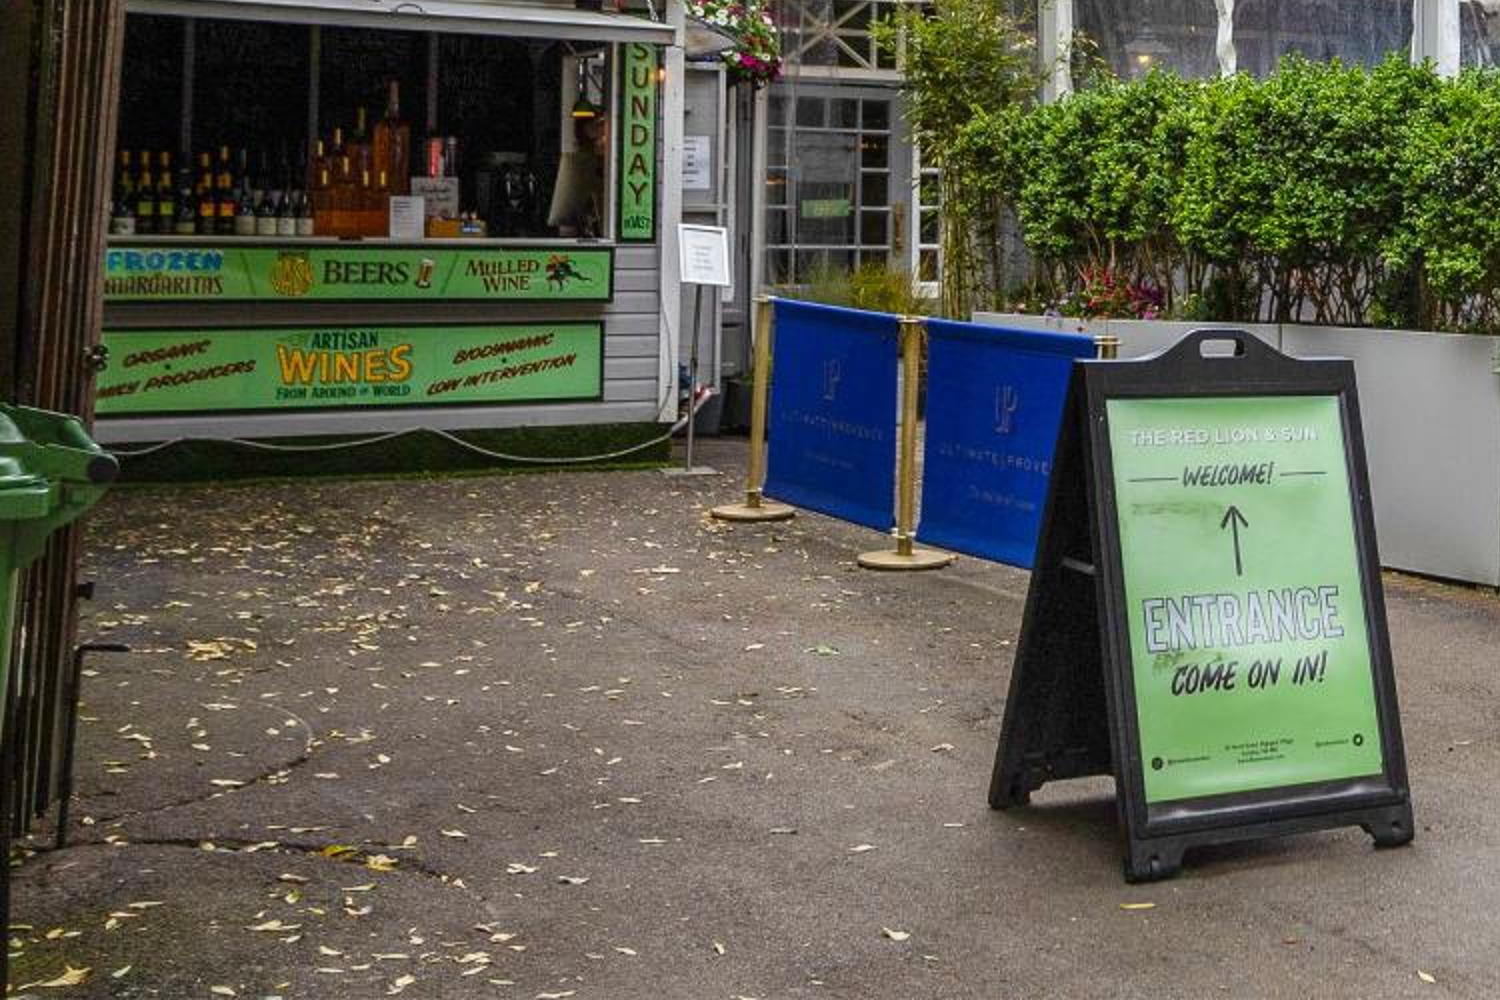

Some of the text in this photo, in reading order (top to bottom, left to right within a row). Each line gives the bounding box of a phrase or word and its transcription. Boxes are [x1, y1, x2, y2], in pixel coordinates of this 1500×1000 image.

[628, 42, 649, 205] SUNDAY
[107, 249, 224, 272] FROZEN
[322, 259, 409, 285] BEERS
[465, 259, 540, 278] MULLED
[482, 275, 530, 293] WINE
[311, 331, 378, 350] ARTISAN
[452, 332, 555, 365] BIODYNAMIC
[143, 359, 257, 392] PRODUCERS
[276, 344, 413, 386] WINES
[461, 353, 577, 388] INTERVENTION
[1133, 425, 1319, 447] THE RED LION & SUN
[1182, 461, 1275, 487] WELCOME!
[1142, 585, 1345, 654] ENTRANCE
[1171, 650, 1328, 696] COME ON IN!
